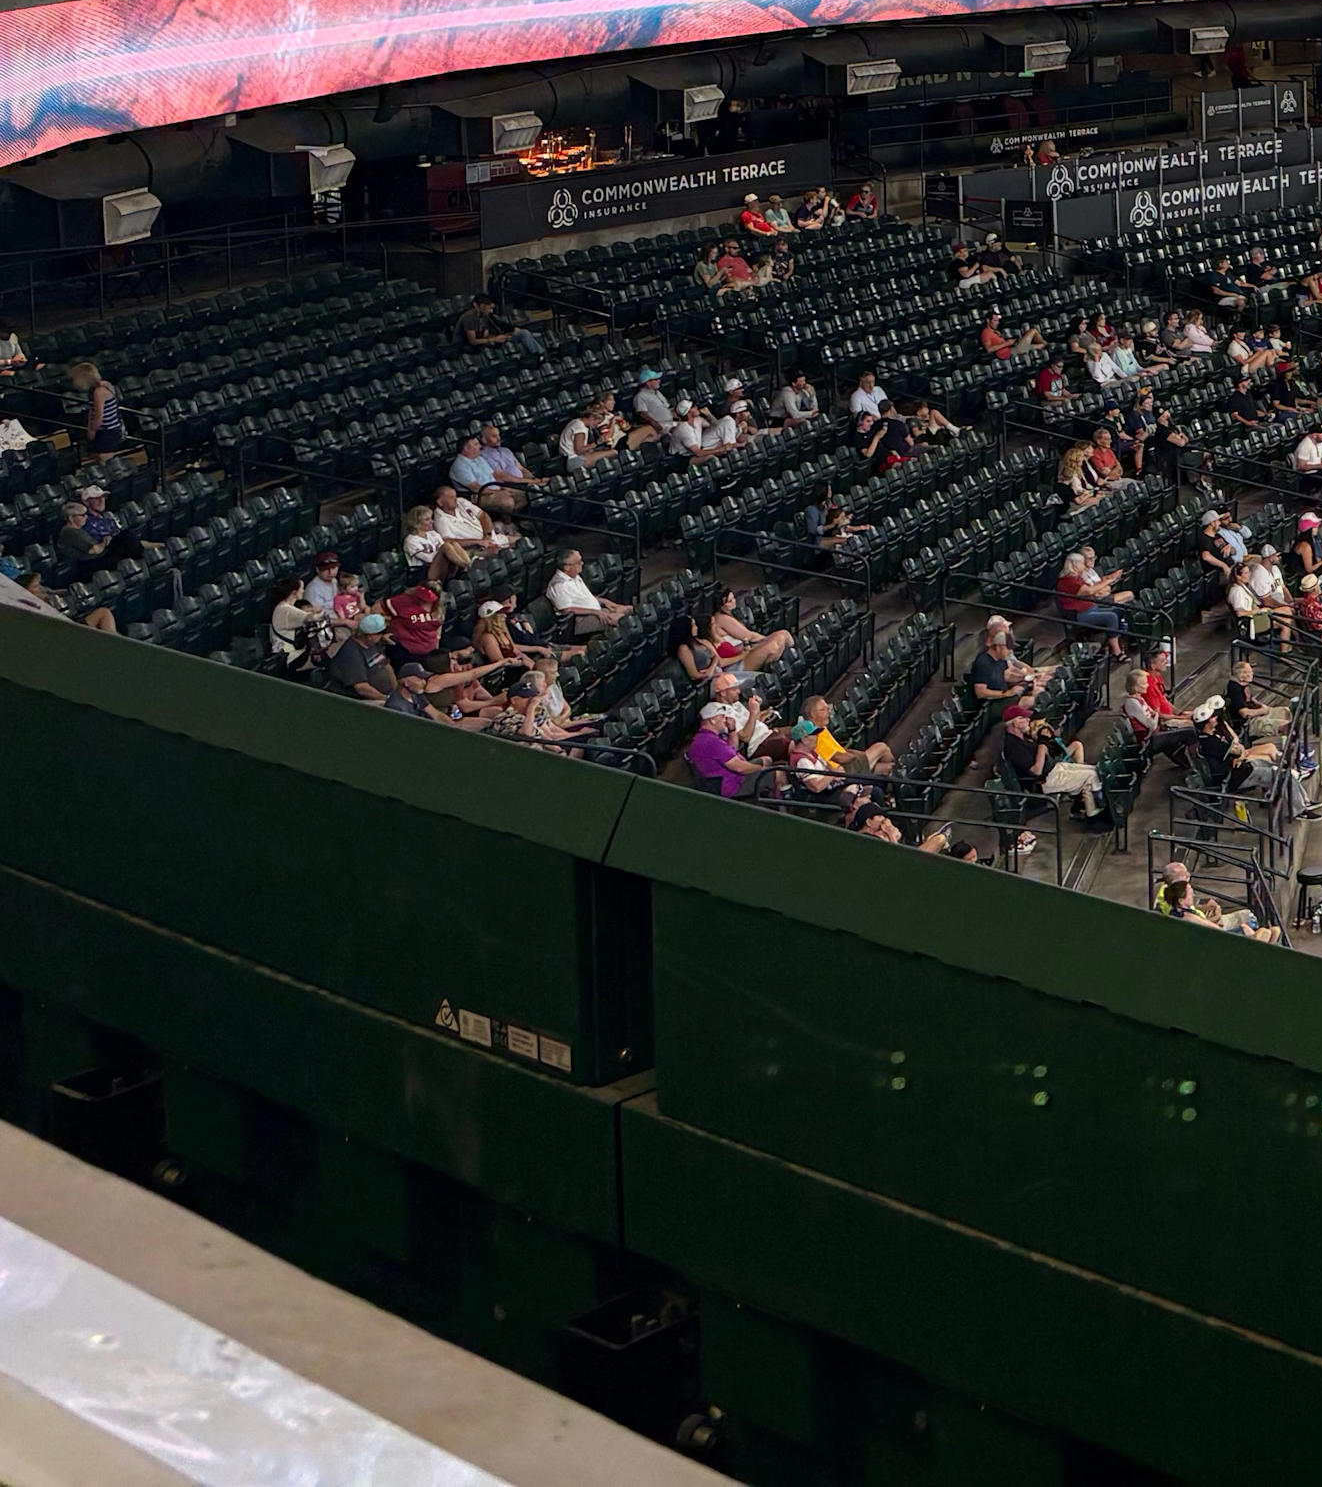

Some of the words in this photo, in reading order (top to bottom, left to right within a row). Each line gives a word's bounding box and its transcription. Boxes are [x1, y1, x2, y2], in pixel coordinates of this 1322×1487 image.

[1069, 127, 1099, 138] TERRACE
[1219, 139, 1283, 161] TERRACE
[581, 171, 717, 205] COMMONWEALTH
[722, 160, 786, 182] TERRACE
[1079, 178, 1139, 194] NSURANCE
[584, 201, 647, 219] INSURANCE
